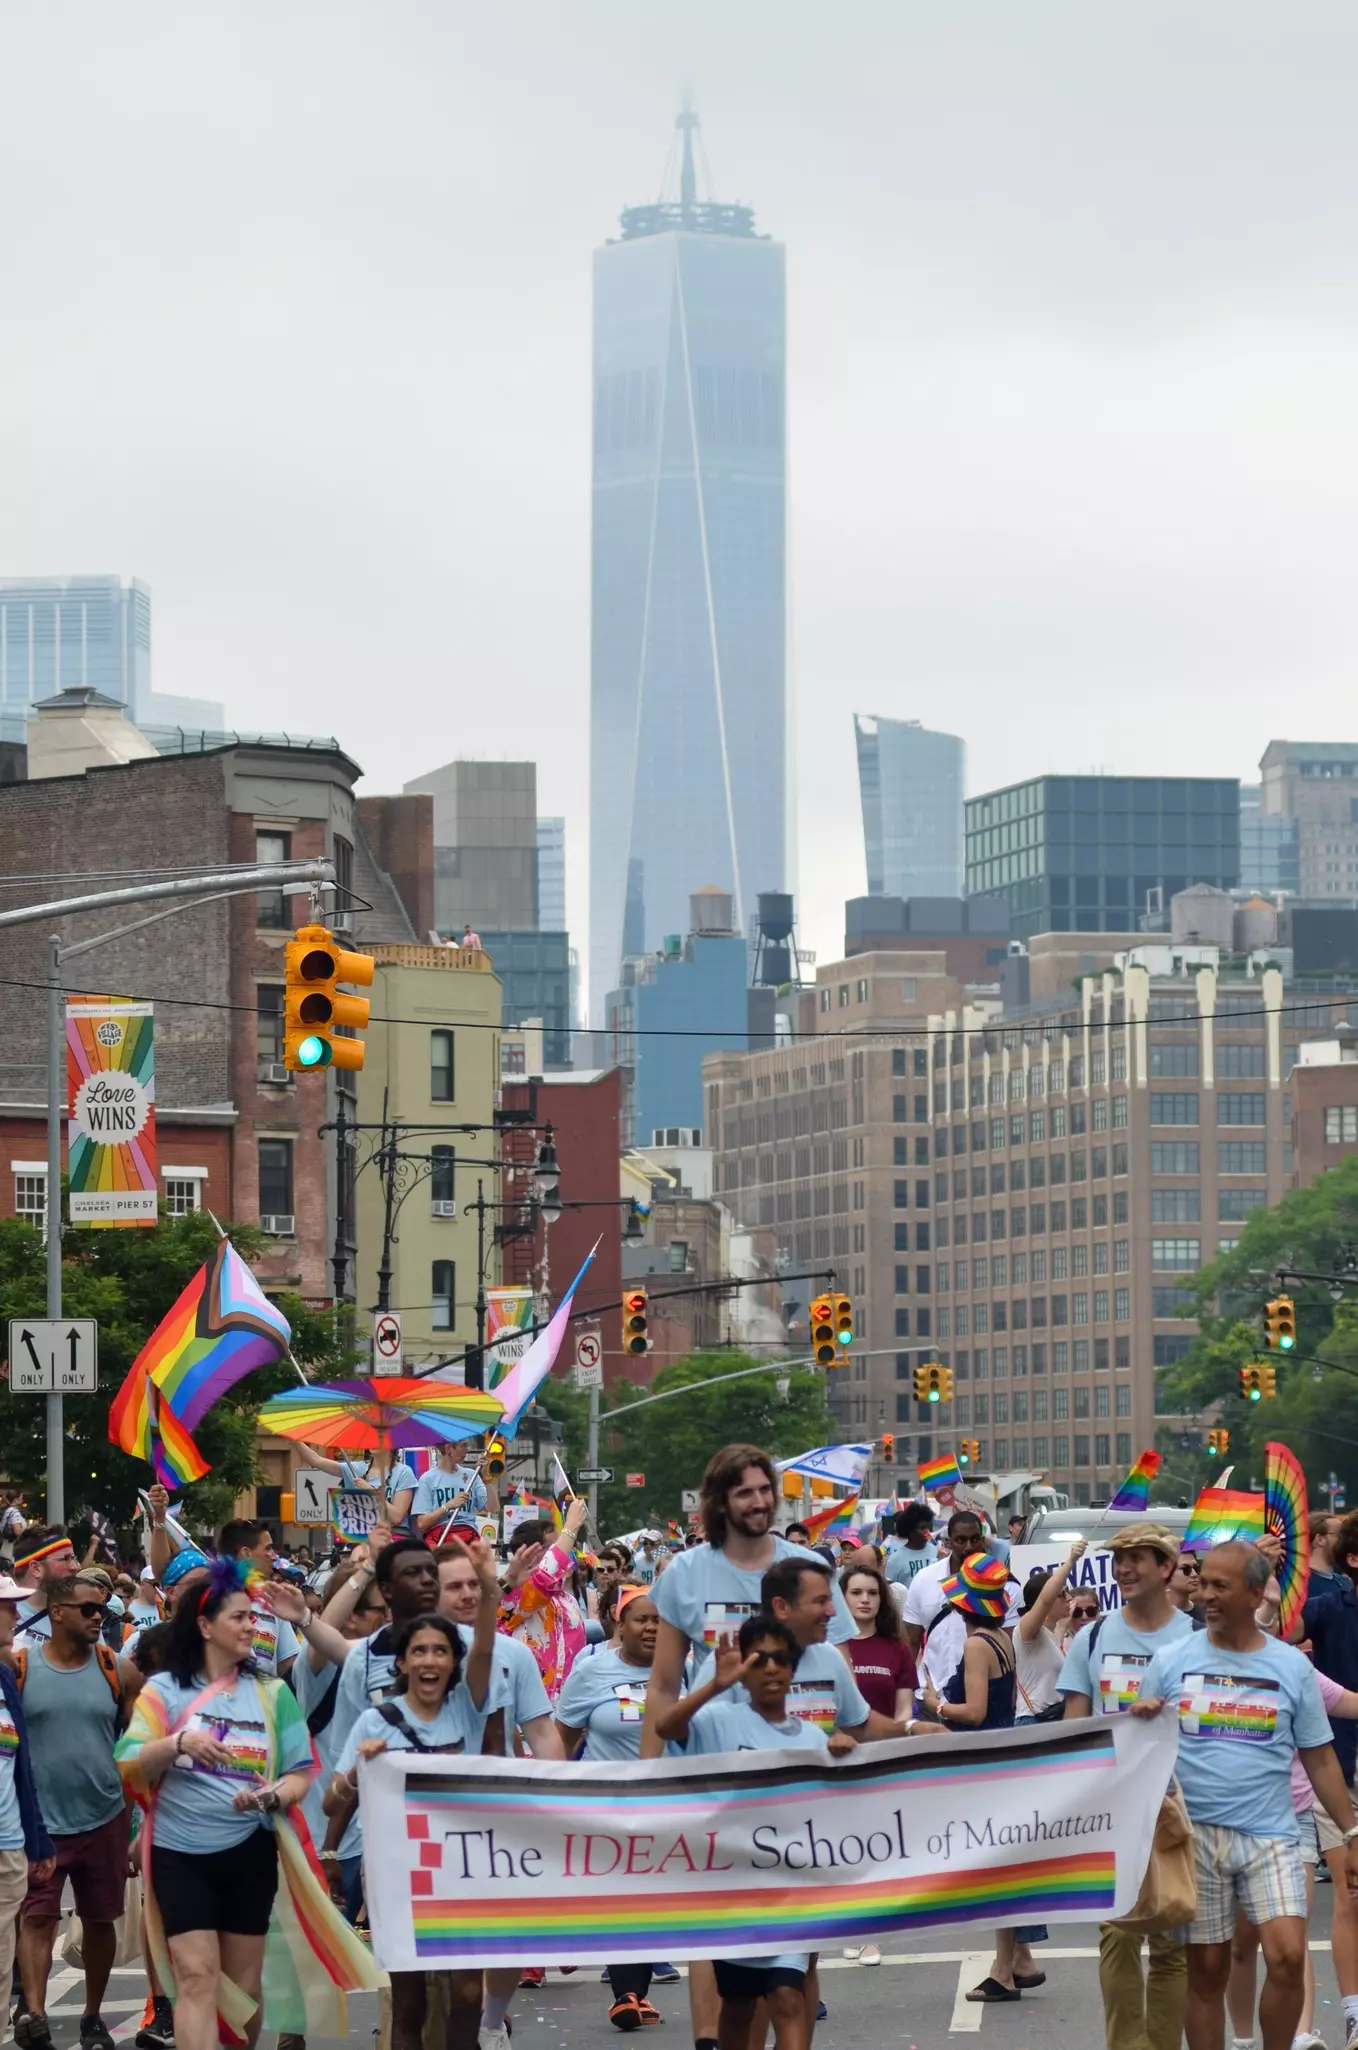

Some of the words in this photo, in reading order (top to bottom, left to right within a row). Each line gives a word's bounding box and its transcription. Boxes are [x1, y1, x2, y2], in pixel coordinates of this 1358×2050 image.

[98, 1029, 122, 1038] VILLAGE
[86, 1081, 136, 1104] Love
[87, 1106, 136, 1130] WINS
[117, 1201, 139, 1209] PIER
[142, 1200, 154, 1208] 57
[498, 1345, 523, 1357] WINS
[20, 1374, 44, 1385] ONLY
[62, 1374, 85, 1385] ONLY
[300, 1510, 323, 1518] ONLY
[445, 1829, 543, 1879] The
[561, 1831, 734, 1877] IDEAL
[751, 1808, 910, 1870] School
[926, 1821, 956, 1860] of
[961, 1810, 1113, 1850] Manhattan
